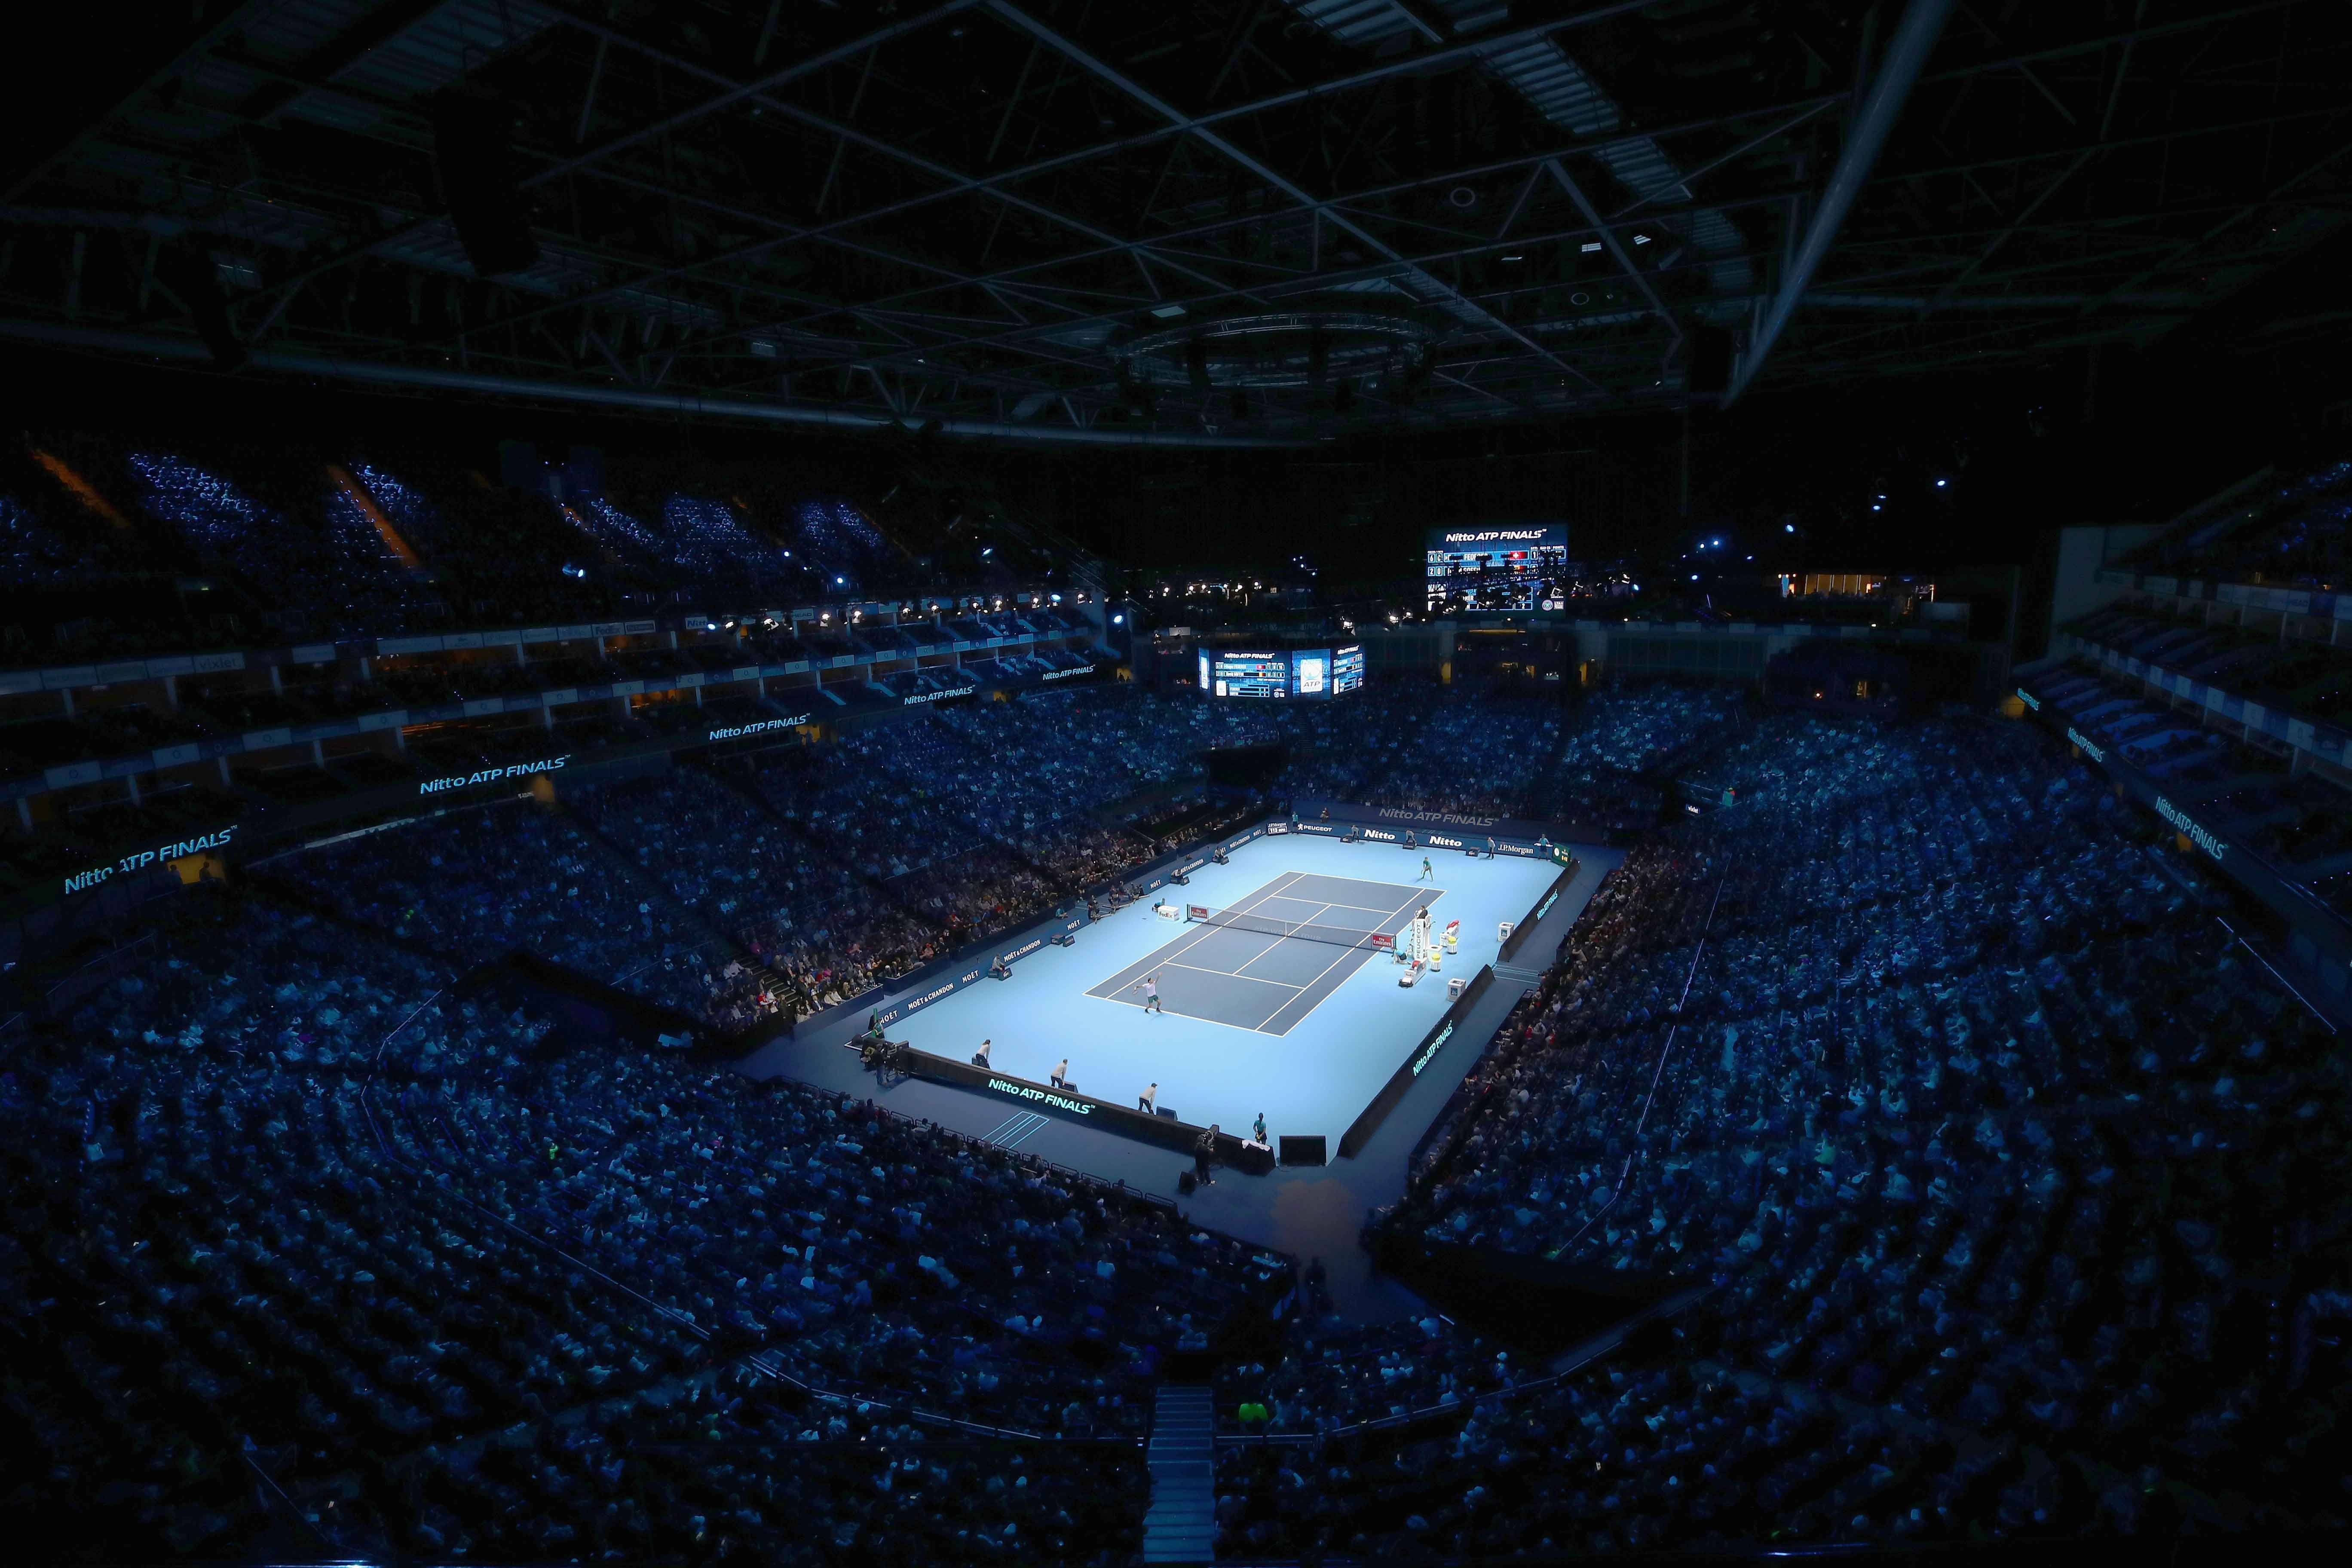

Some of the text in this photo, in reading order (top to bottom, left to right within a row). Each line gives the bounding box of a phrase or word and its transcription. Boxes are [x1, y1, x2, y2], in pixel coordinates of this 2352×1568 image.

[1446, 533, 1475, 542] Nitto
[1476, 532, 1499, 541] ATP
[1043, 672, 1059, 680] Nitto
[1060, 670, 1072, 678] ATP
[904, 696, 926, 705] Nitto
[927, 692, 943, 701] ATP
[710, 728, 741, 741] Nitto
[742, 723, 765, 735] ATP
[420, 777, 466, 794] Nitto
[468, 769, 503, 785] ATP
[1379, 808, 1413, 820] Nitto
[1413, 811, 1442, 822] ATP
[2155, 796, 2175, 822] Nitto
[2173, 812, 2192, 832] ATP
[1364, 829, 1396, 840] Nitto
[1429, 836, 1463, 847] Nitto
[1498, 844, 1534, 855] J.P.Morgan
[65, 867, 113, 894] Nitto
[1020, 939, 1041, 954] CHANDON
[928, 983, 954, 1000] CHANDON
[1413, 1056, 1427, 1077] Nitto
[1426, 1042, 1436, 1061] ATP
[989, 1078, 1019, 1095] Nitto
[1020, 1087, 1044, 1102] ATP
